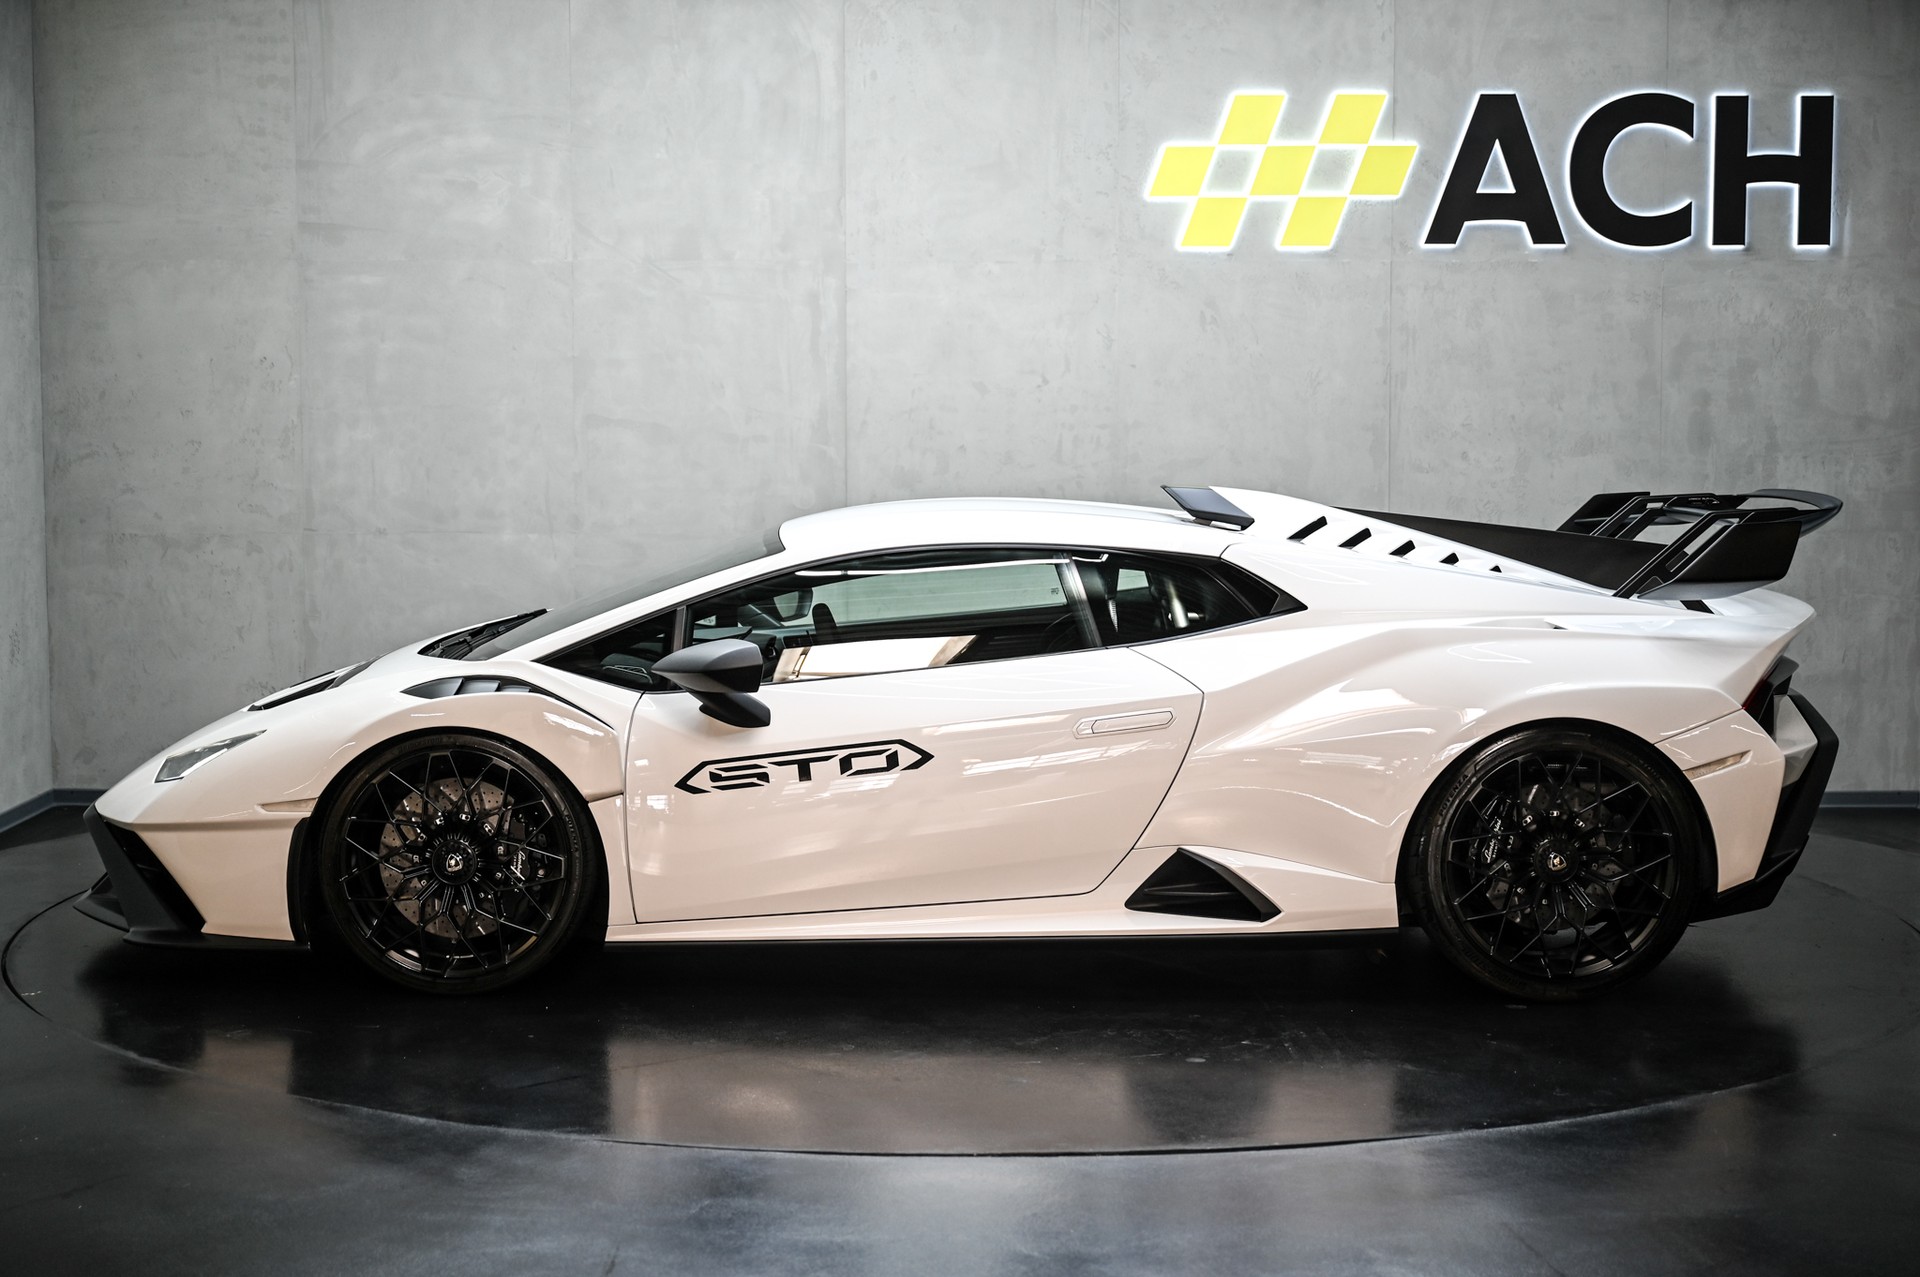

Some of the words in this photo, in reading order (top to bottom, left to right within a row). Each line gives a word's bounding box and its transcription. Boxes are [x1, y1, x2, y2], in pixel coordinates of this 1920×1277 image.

[1423, 92, 1835, 248] ACH
[709, 747, 900, 792] STO
[1438, 774, 1469, 817] POTENZA
